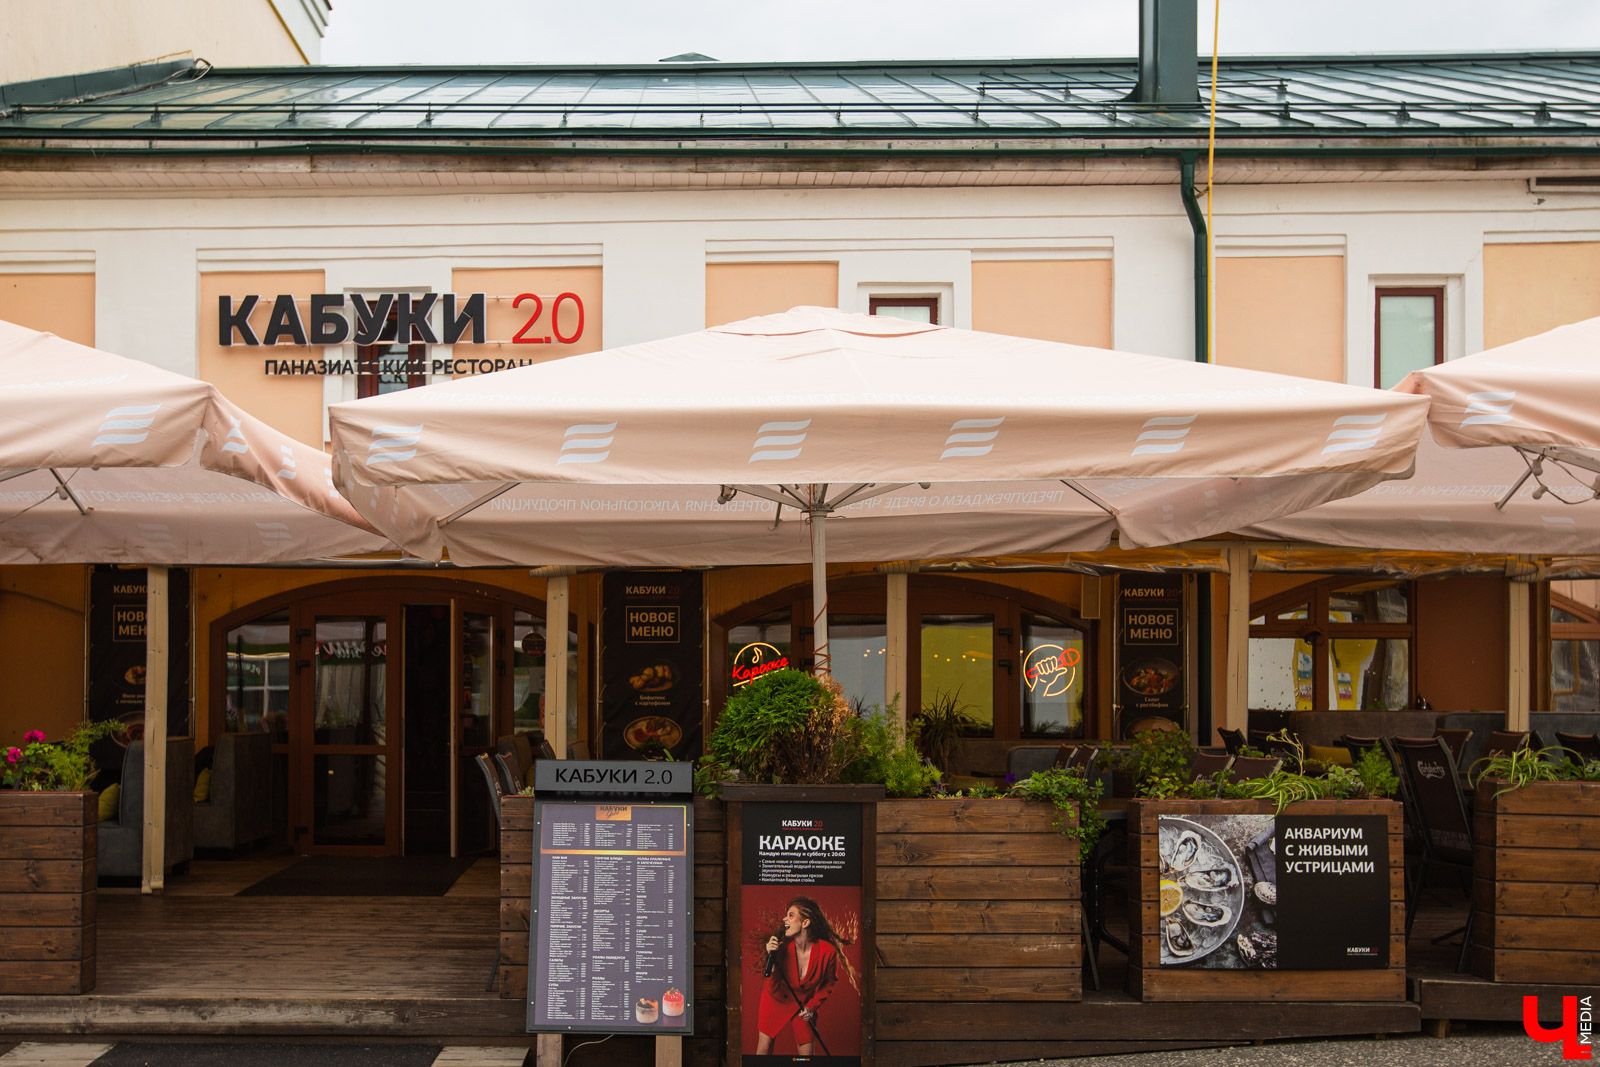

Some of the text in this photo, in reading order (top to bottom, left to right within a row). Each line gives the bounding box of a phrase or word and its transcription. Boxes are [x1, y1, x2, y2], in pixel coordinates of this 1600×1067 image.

[218, 292, 585, 346] КАБУКИ 2.0
[264, 357, 425, 376] ПАНАЗИАТСКИЙ
[625, 585, 666, 595] КАБУКИ
[1124, 587, 1164, 597] КАБУКИ
[117, 611, 147, 623] НОВ
[629, 612, 676, 623] НОВОЕ
[1128, 614, 1174, 625] НОВОЕ
[118, 625, 147, 637] МЕН
[631, 626, 674, 637] МЕНЮ
[1130, 628, 1173, 639] МЕНЮ
[555, 768, 673, 785] КАБУКИ 2.0
[1284, 827, 1362, 840] АКВАРИУМ
[759, 835, 845, 851] КАРАОКЕ
[1284, 844, 1368, 856] С ЖИВЫМИ
[1285, 861, 1374, 875] УСТРИЦАМИ
